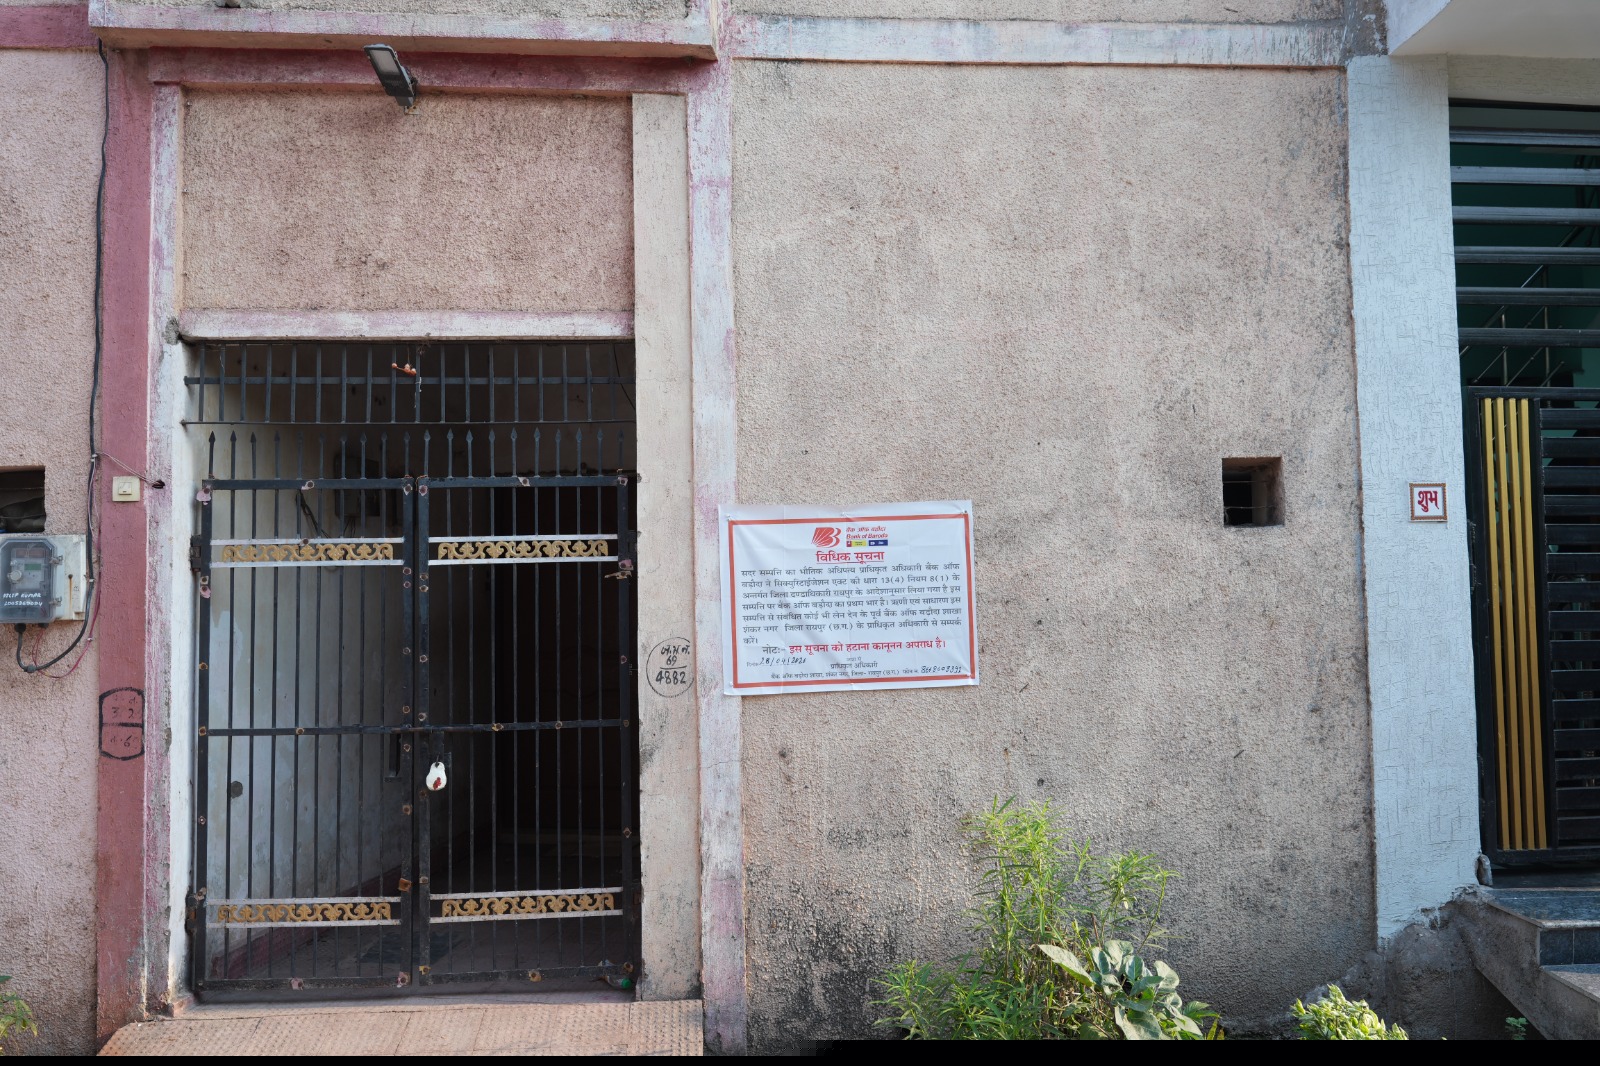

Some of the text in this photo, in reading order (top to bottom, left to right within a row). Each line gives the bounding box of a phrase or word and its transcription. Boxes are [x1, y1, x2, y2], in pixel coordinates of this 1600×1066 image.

[1418, 491, 1439, 512] शुभ
[816, 550, 884, 564] विधिक सूचना
[800, 566, 822, 574] भौतिक
[860, 565, 887, 574] प्राधिकृत
[925, 562, 939, 570] बैंक
[770, 590, 788, 598] जिला
[833, 589, 852, 598] रायपुर
[866, 586, 905, 596] आदेशानुसार
[942, 584, 948, 593] है
[742, 602, 764, 611] सम्पत्ति
[743, 613, 765, 622] सम्पत्ति
[804, 611, 818, 620] कोई
[821, 610, 830, 618] भी
[847, 610, 857, 618] देन
[870, 609, 881, 619] पूर्व
[883, 608, 897, 616] बैंक
[743, 625, 761, 633] शंकर
[785, 624, 803, 632] जिला
[806, 624, 826, 633] रायपुर
[867, 620, 895, 630] प्राधिकृत
[898, 619, 929, 628] अधिकारी
[940, 617, 962, 626] सम्पर्क
[789, 645, 802, 655] इस
[805, 645, 828, 656] सूचना
[831, 641, 843, 651] को
[846, 642, 869, 652] हटाना
[872, 641, 902, 652] कानूनन
[906, 640, 933, 649] अपराध
[666, 655, 677, 666] 69
[656, 670, 686, 684] 4882
